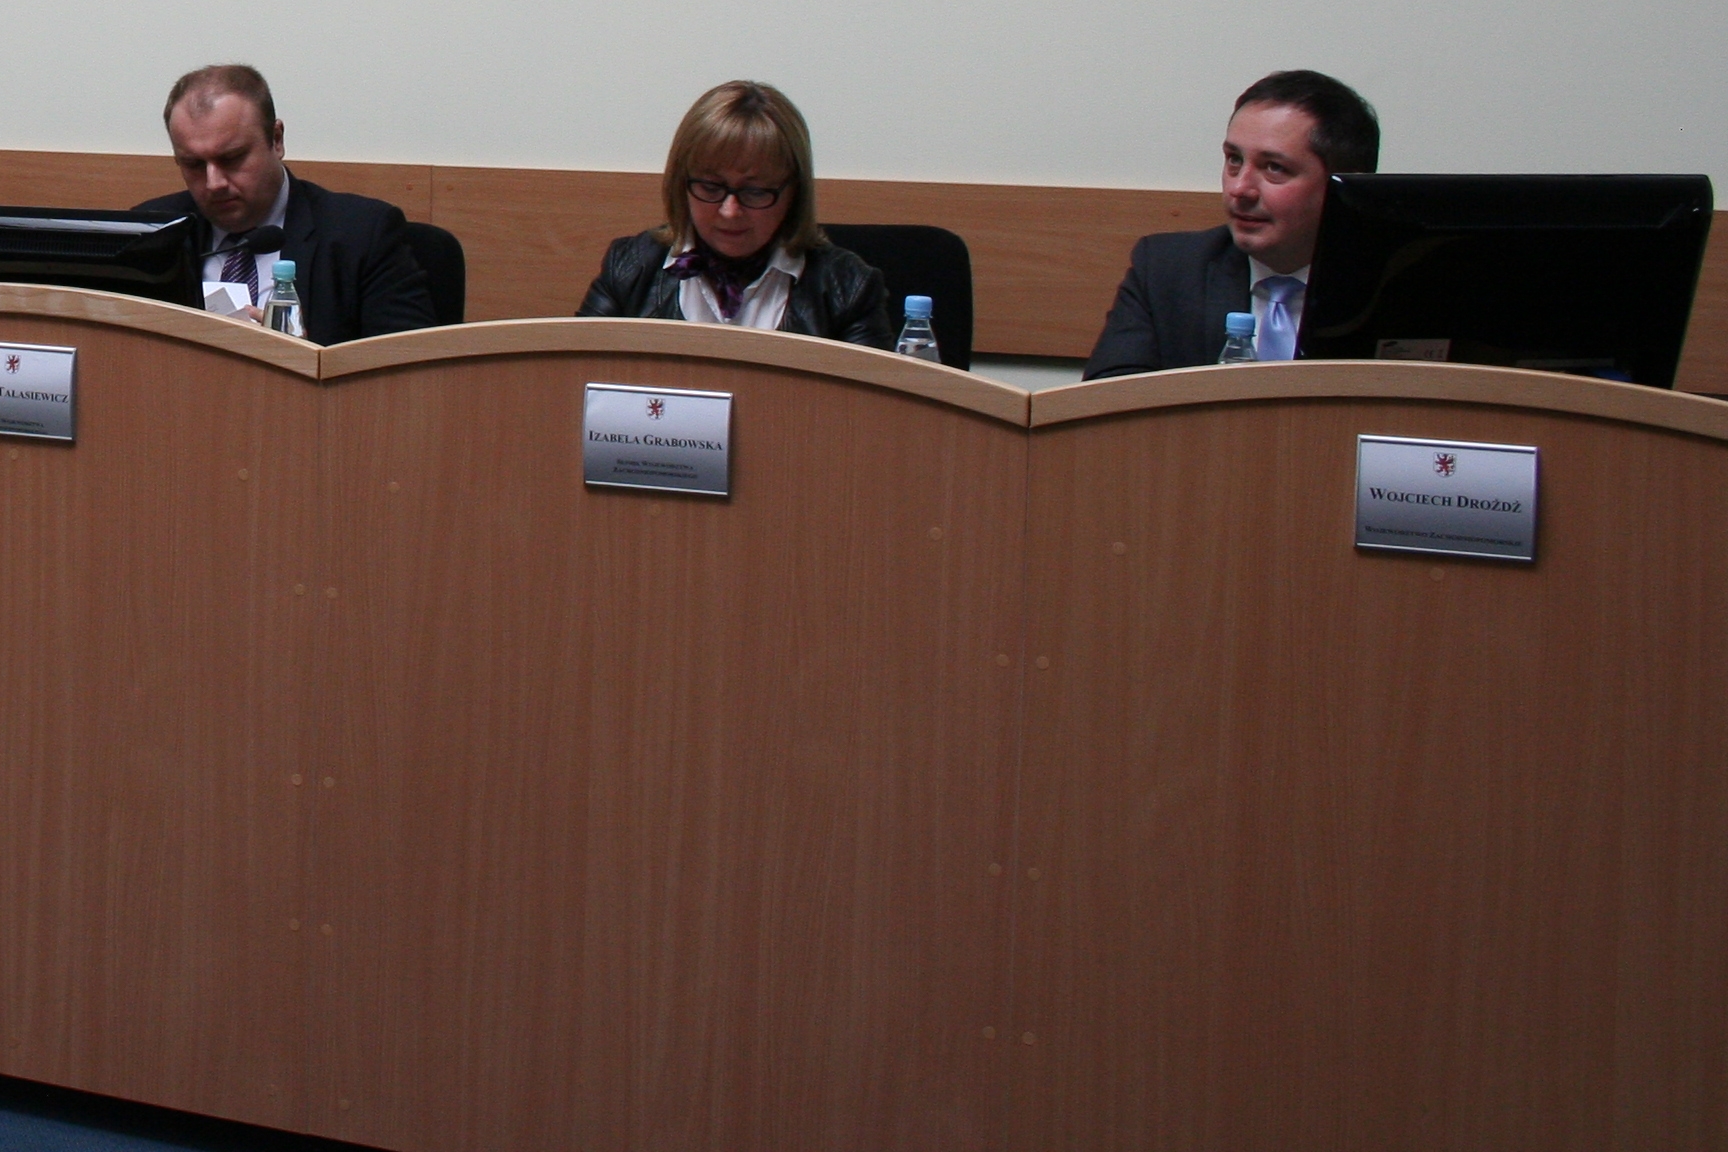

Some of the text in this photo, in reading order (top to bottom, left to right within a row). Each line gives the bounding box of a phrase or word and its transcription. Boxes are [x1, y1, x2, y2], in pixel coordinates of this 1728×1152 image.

[589, 430, 723, 450] IZABELA GRABOWSKA
[1369, 487, 1451, 507] WOJCIECH
